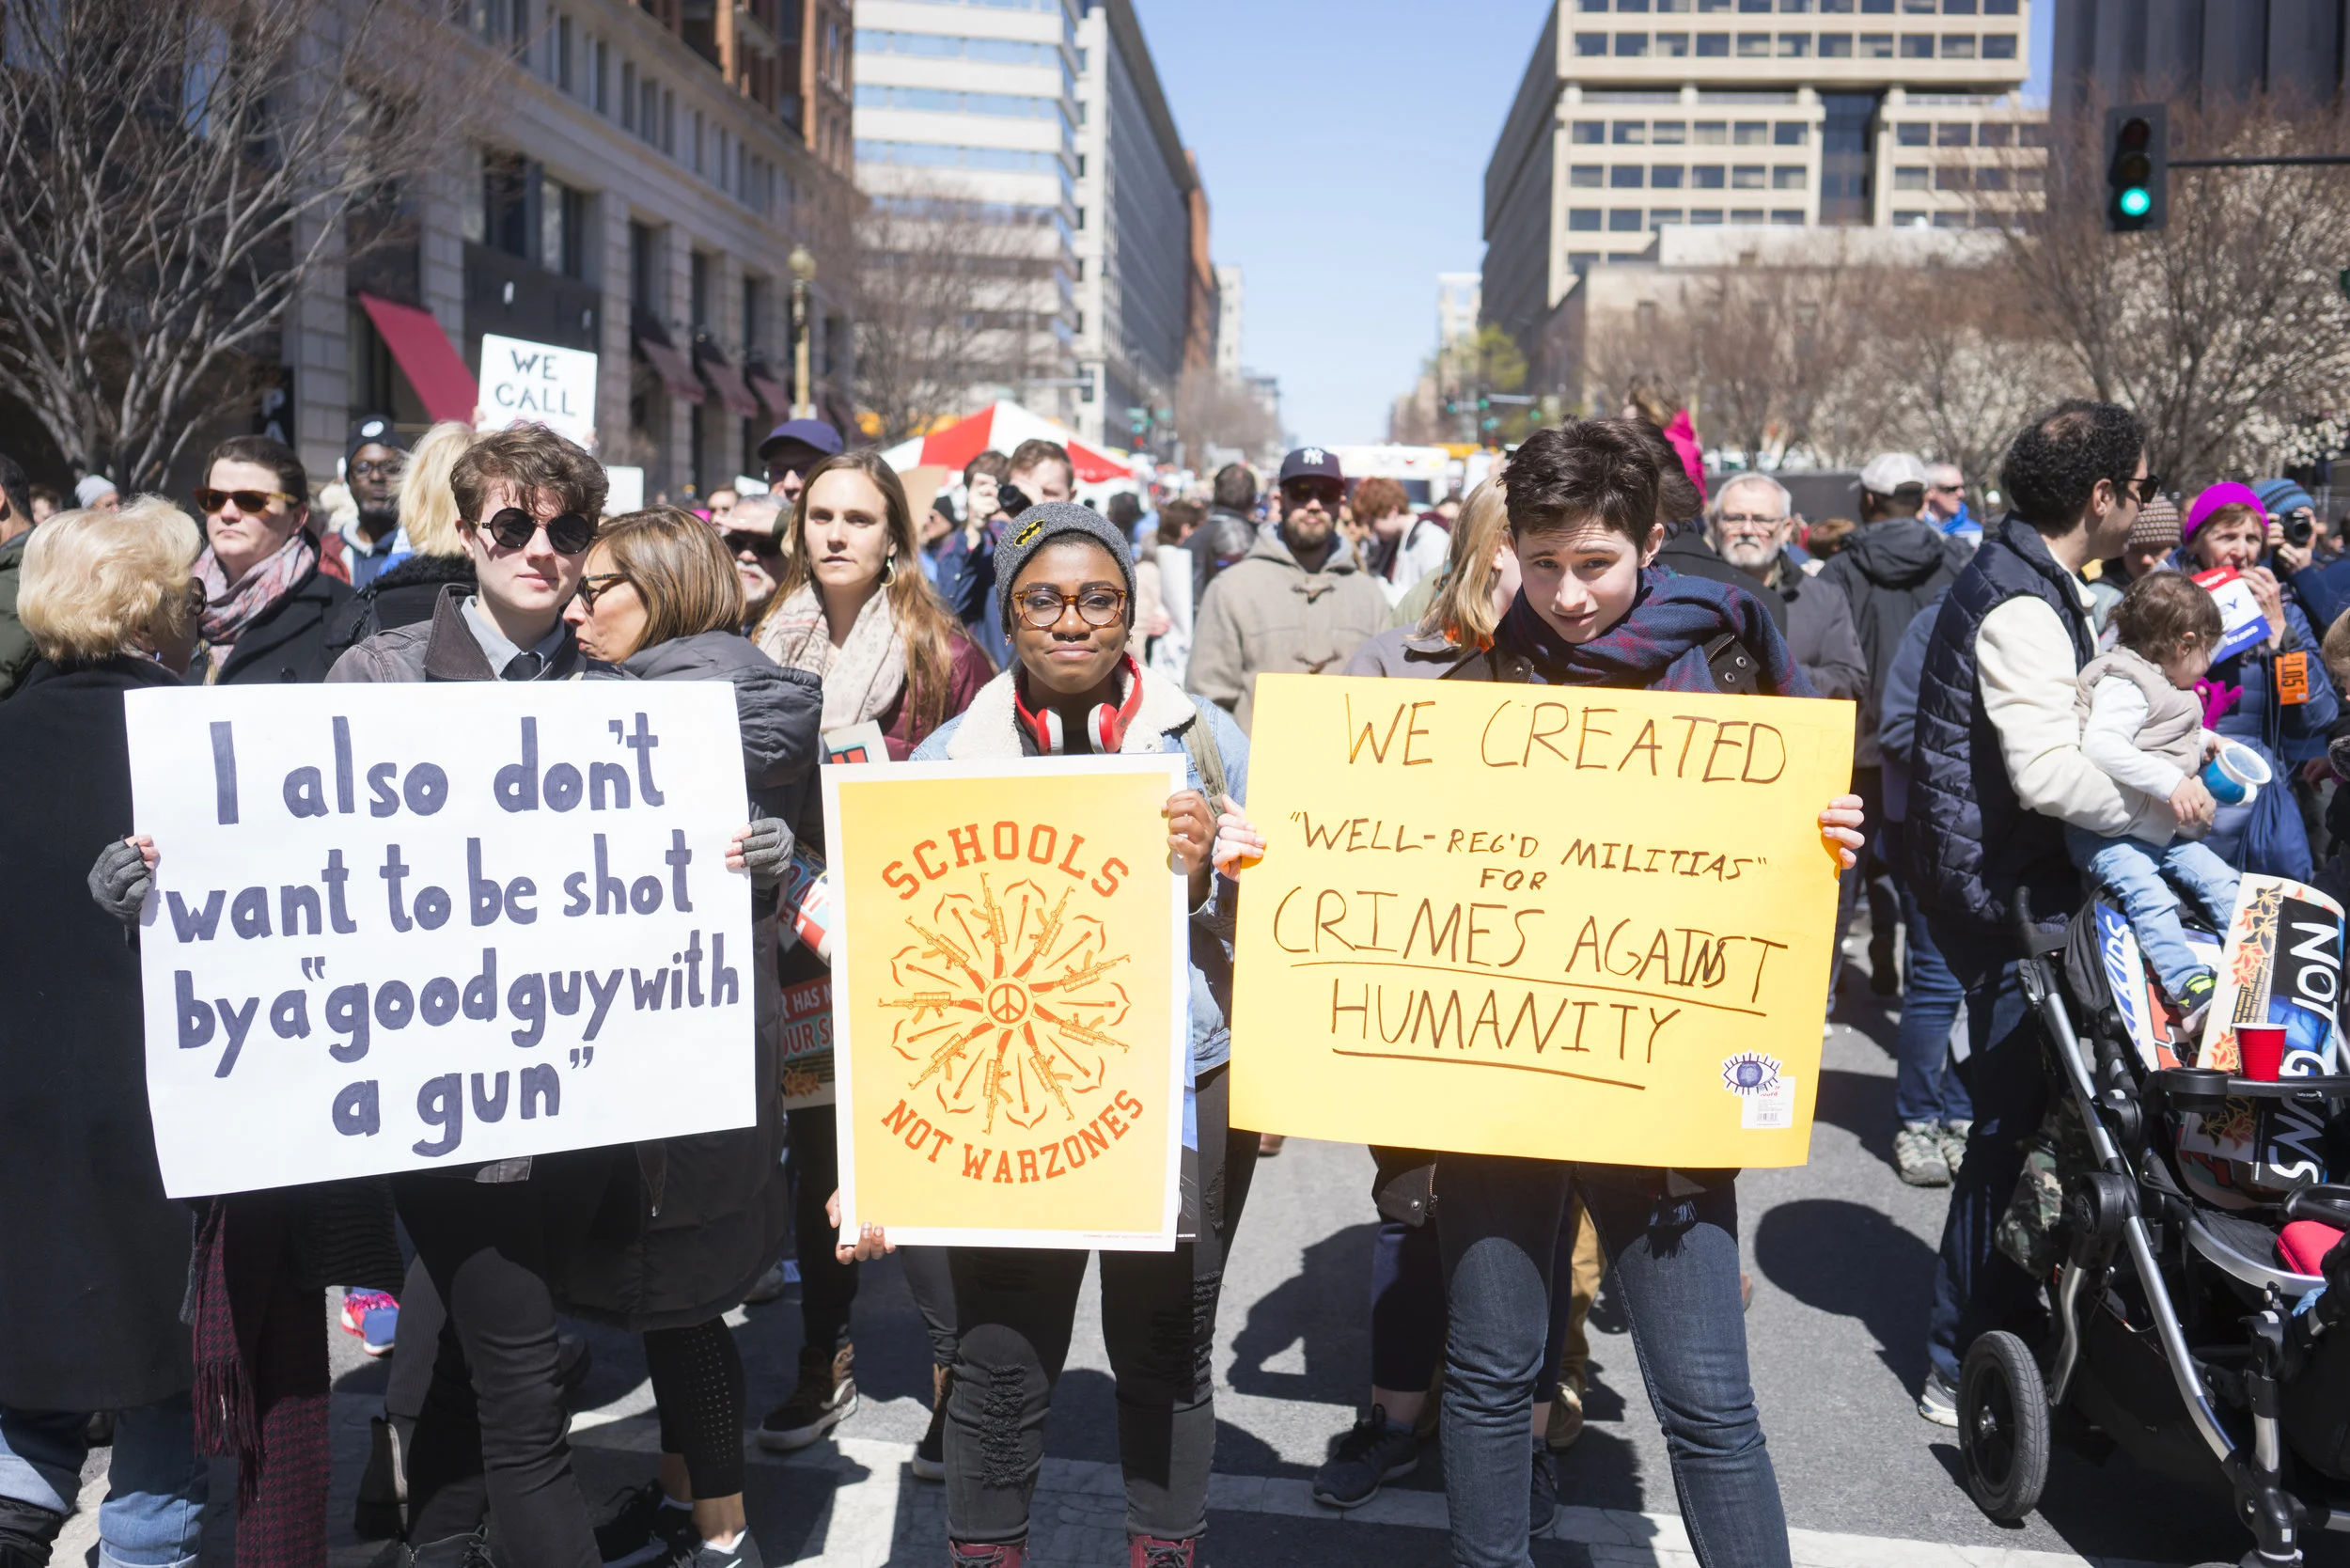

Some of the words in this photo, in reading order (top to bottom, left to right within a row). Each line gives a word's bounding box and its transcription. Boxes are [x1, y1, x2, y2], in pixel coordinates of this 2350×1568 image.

[495, 382, 576, 417] CALL
[510, 349, 557, 381] WE
[211, 721, 239, 824] I
[283, 716, 448, 818] also
[494, 712, 665, 813] don't
[1346, 693, 1436, 765] WE
[1481, 700, 1786, 784] CREATED
[166, 849, 357, 943] want
[379, 843, 452, 932] to
[467, 837, 538, 926] be
[563, 829, 693, 917] shot
[882, 821, 1130, 901] SCHOOLS
[1480, 868, 1547, 891] FOR
[1560, 839, 1768, 881] MILITIAS"
[1274, 886, 1545, 968] CRIMES
[1565, 916, 1789, 1003] AGAINST
[2290, 922, 2341, 1038] NOT
[175, 969, 259, 1077] by
[507, 968, 624, 1047] guy
[629, 930, 740, 1011] with
[792, 986, 821, 1012] HAS
[1331, 978, 1682, 1063] HUMANITY
[332, 1080, 381, 1137] a
[413, 1046, 594, 1158] gun"
[881, 1099, 956, 1165] NOT
[962, 1090, 1144, 1184] WARZONES
